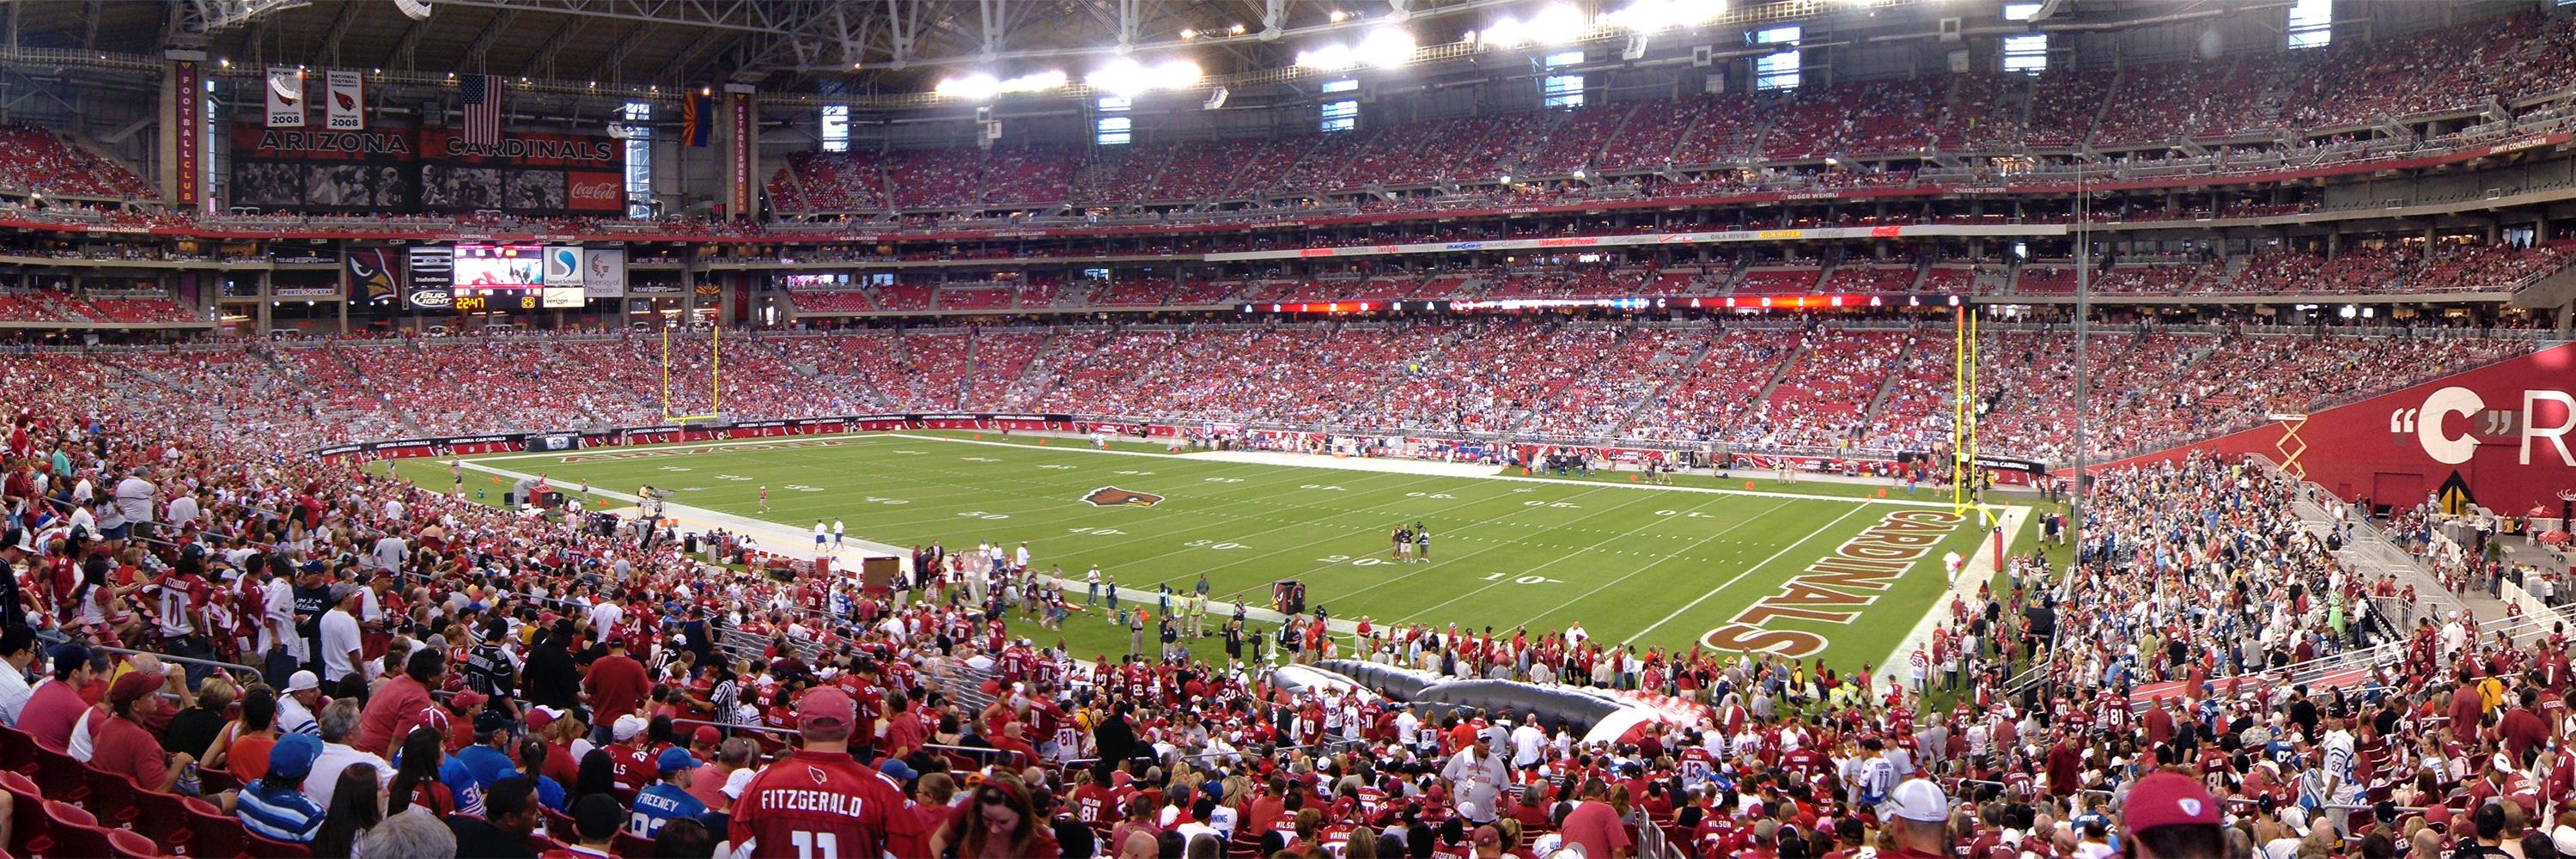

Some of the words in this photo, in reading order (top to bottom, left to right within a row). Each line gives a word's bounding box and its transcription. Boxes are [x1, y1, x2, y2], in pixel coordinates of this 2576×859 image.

[258, 131, 410, 154] ARIZONA
[446, 137, 612, 161] CARDINALS
[456, 297, 484, 308] 22:47
[523, 298, 533, 308] 25
[2519, 389, 2576, 466] R
[958, 510, 1010, 521] 50
[1068, 527, 1128, 536] 40
[1184, 539, 1253, 551] 30
[1317, 554, 1399, 567] 20
[1481, 571, 1566, 585] 10
[1700, 510, 1967, 660] CARDINALS
[1008, 658, 1019, 673] 11
[1365, 714, 1374, 728] 11
[2110, 709, 2123, 725] 81
[1061, 729, 1073, 746] 81
[2331, 760, 2342, 773] 87
[2556, 756, 2567, 768] 11
[1797, 765, 1807, 783] 7
[2208, 771, 2224, 792] 81
[637, 793, 681, 812] FREENEY
[761, 789, 863, 817] FITZGERALD
[1081, 796, 1101, 808] BOLDIN
[1081, 807, 1099, 822] 81
[1275, 819, 1295, 830] WILSO
[1708, 820, 1732, 829] WILSON
[1330, 831, 1351, 840] WARNE
[791, 830, 838, 859] 11
